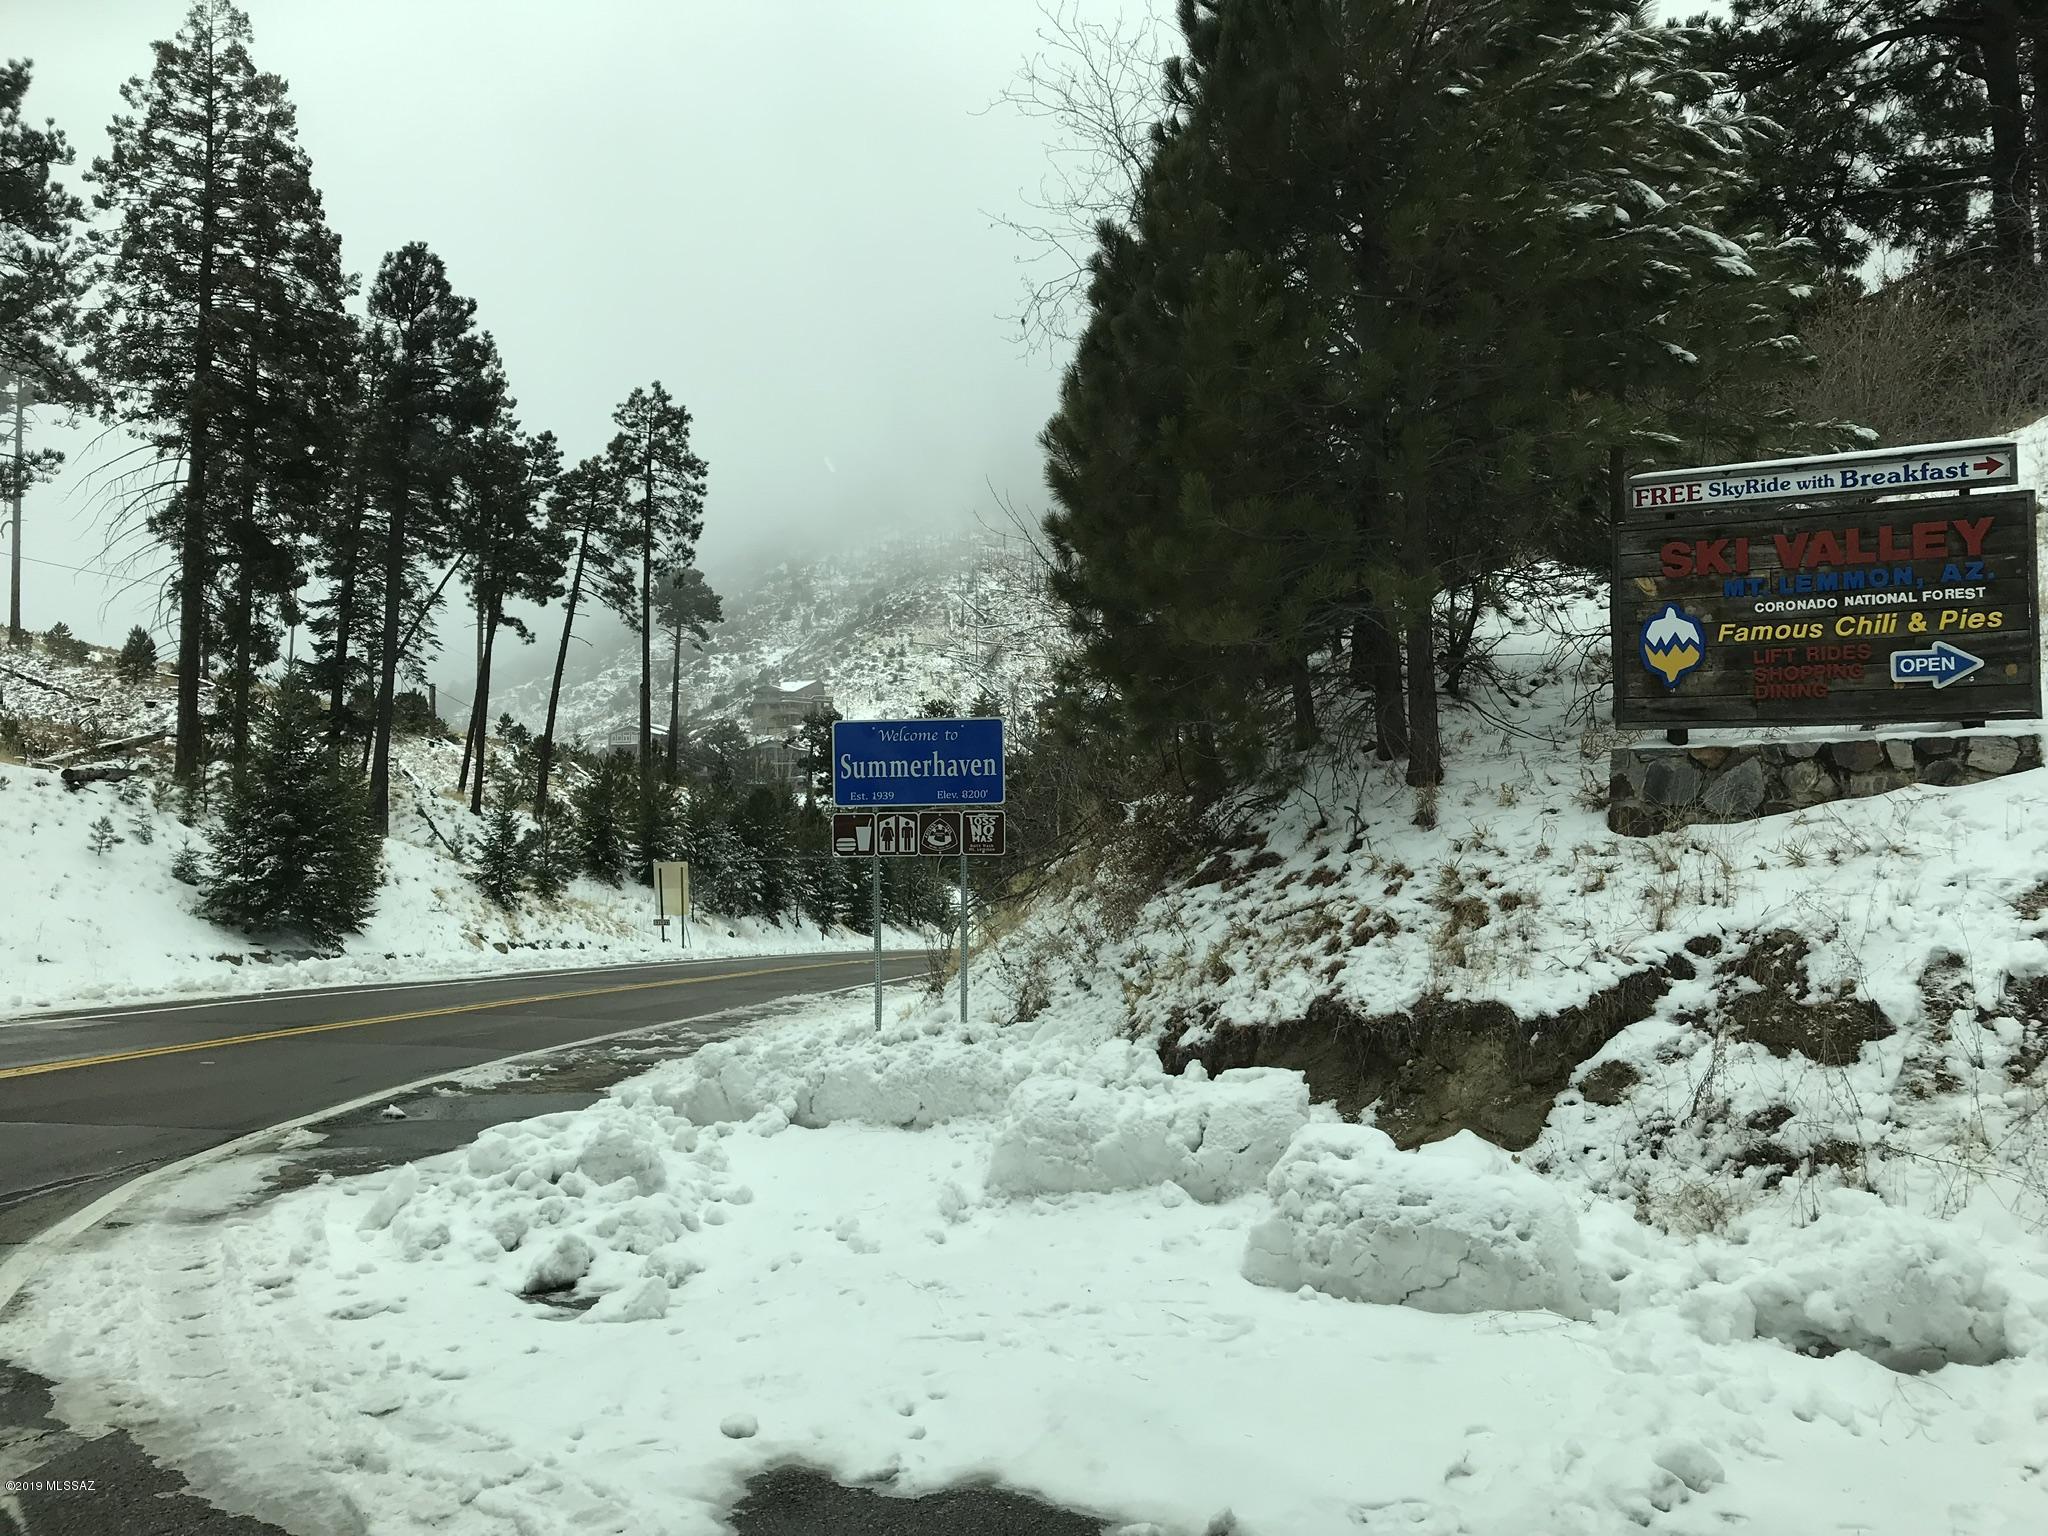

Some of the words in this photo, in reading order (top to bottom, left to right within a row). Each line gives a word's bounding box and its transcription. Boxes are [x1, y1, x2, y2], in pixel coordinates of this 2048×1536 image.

[1635, 483, 1703, 507] FREE
[1708, 476, 1790, 499] SkyRide
[1796, 474, 1835, 491] with
[1840, 461, 1970, 489] Breakfast
[1660, 537, 1749, 578] SKI
[1774, 516, 1995, 570] VALLEY
[1779, 566, 1924, 595] LEMMON,
[1941, 560, 1995, 582] AZ.
[1754, 598, 1838, 613] CORONADO
[1844, 592, 1917, 607] NATIONAL
[1922, 586, 1986, 602] FOREST
[1717, 622, 1824, 643] Famous
[1835, 612, 1898, 637] Chili
[1908, 612, 1927, 633] &
[1938, 608, 2003, 631] Pies
[1753, 647, 1796, 665] LIFT
[1806, 643, 1872, 662] RIDES
[1900, 656, 1955, 673] OPEN
[1754, 663, 1865, 683] SHOPPING
[1755, 684, 1829, 700] DINING
[878, 726, 938, 742] Welcome
[945, 728, 958, 741] to
[840, 751, 997, 779] Summerhaven
[850, 791, 868, 801] Est.
[872, 791, 895, 801] 1939
[937, 790, 958, 800] Elev.
